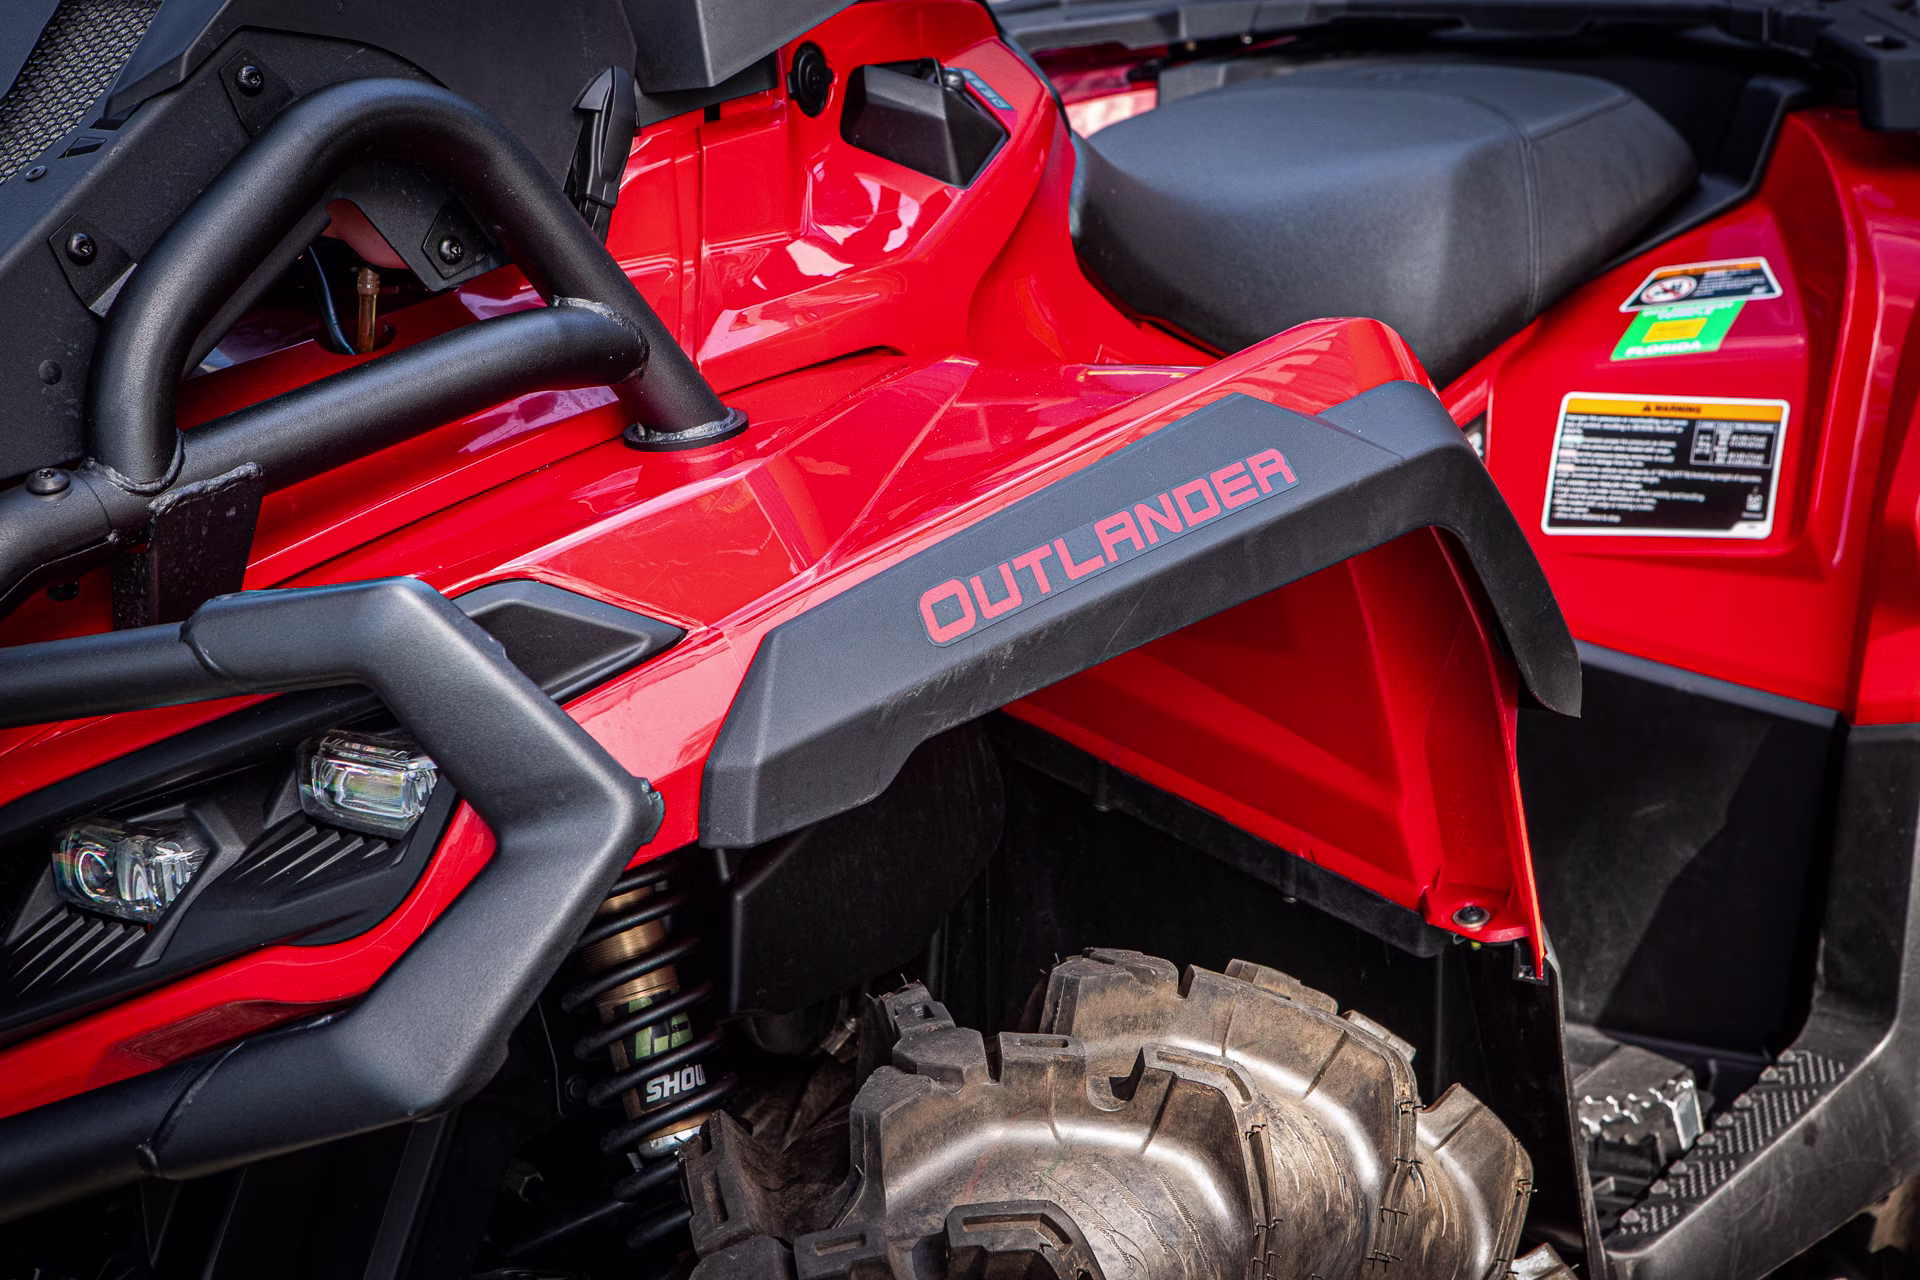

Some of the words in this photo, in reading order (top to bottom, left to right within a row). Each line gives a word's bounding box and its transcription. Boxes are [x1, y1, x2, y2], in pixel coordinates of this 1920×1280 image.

[1625, 340, 1702, 357] FLORIDA
[1655, 405, 1702, 414] WARNING
[919, 448, 1297, 644] OUTLANDER
